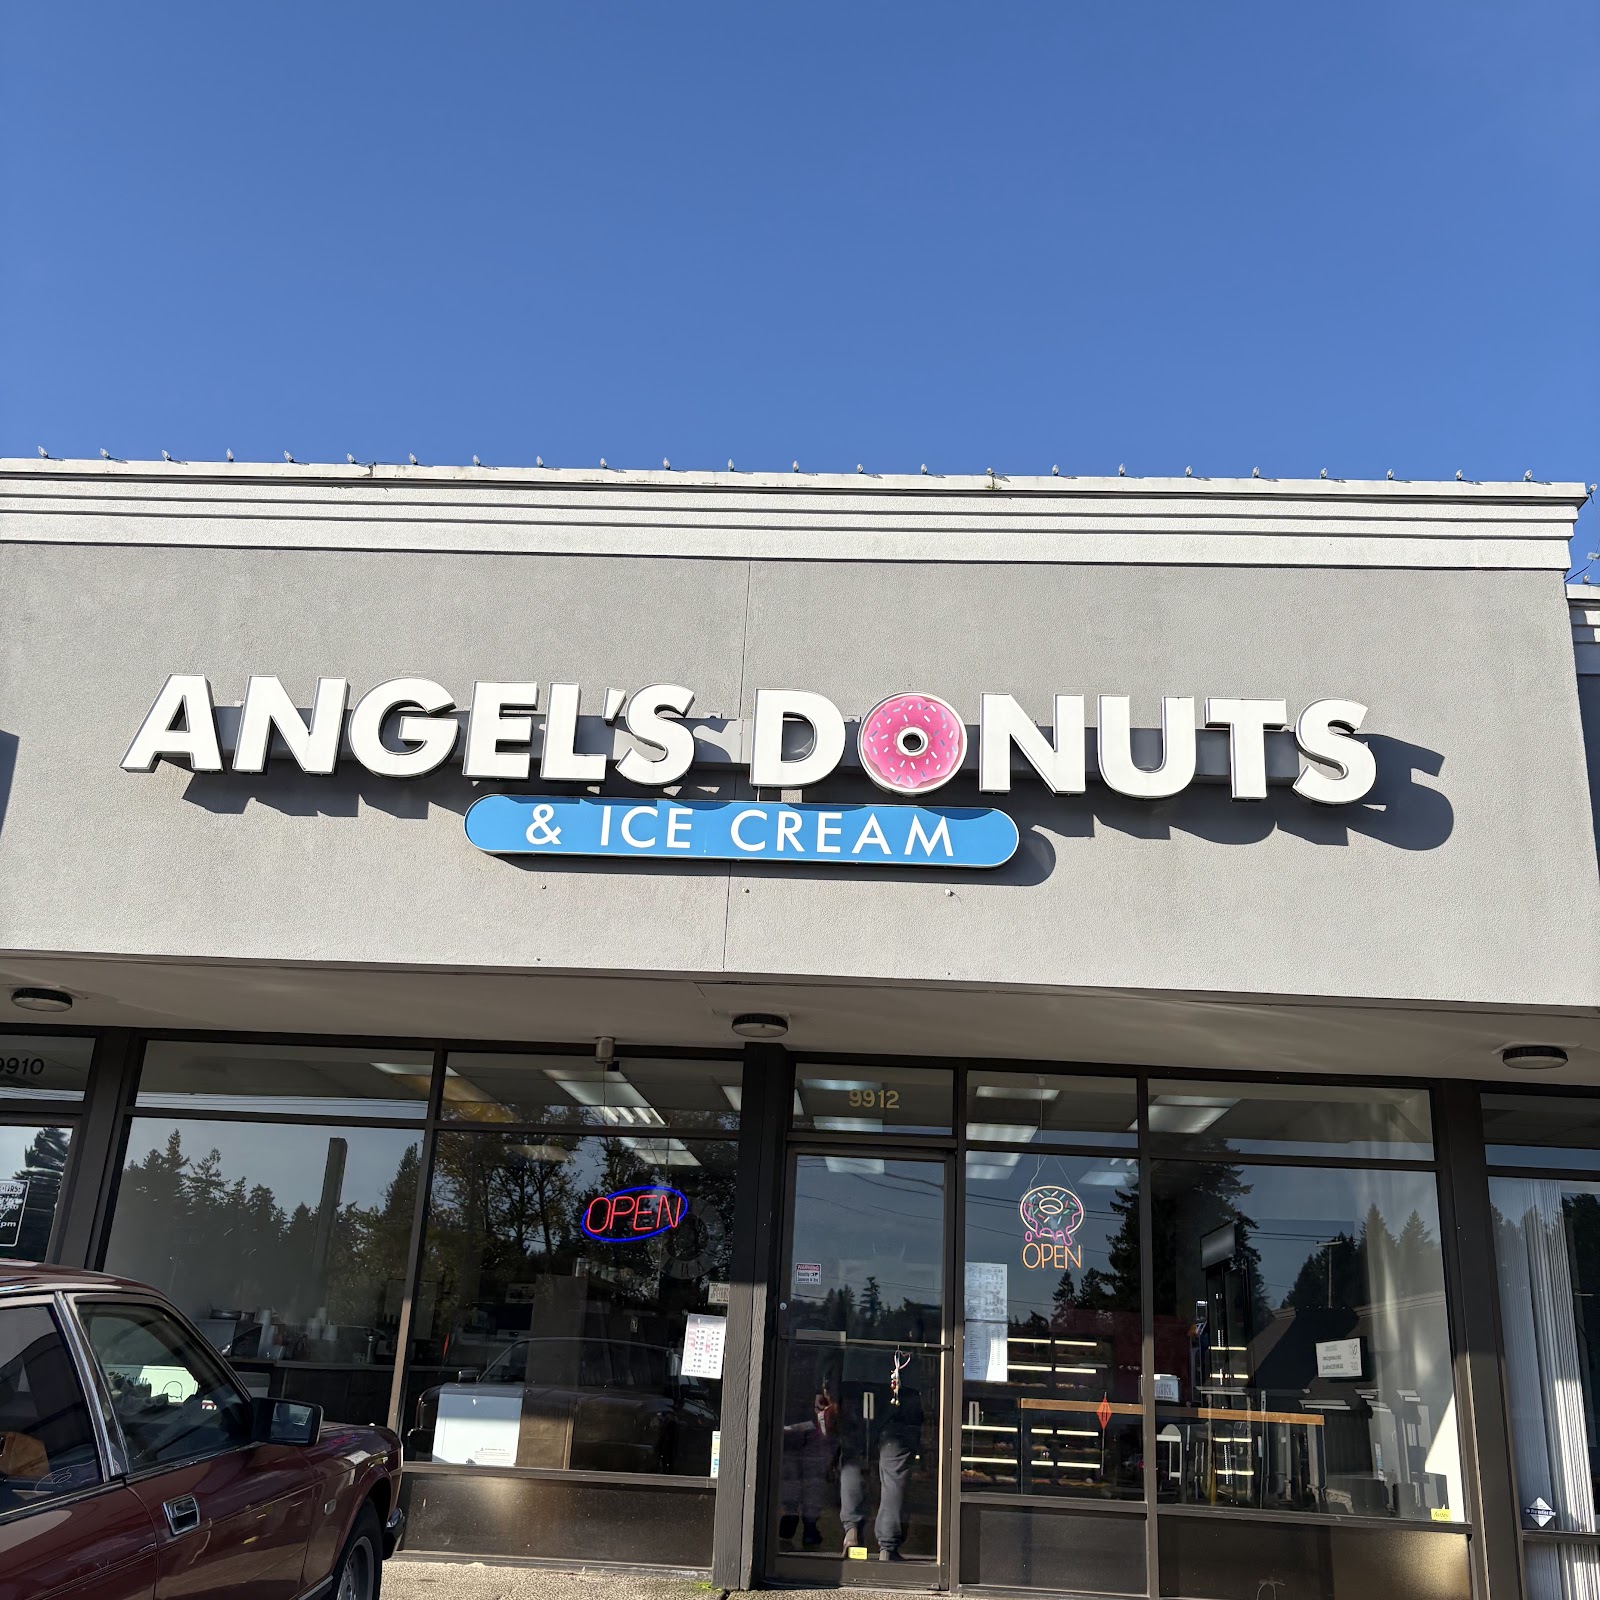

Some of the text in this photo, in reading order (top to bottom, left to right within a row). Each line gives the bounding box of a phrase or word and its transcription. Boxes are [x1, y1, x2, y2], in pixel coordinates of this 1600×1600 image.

[120, 674, 1378, 804] ANGEL'S DONUTS
[525, 804, 955, 859] & ICE CREAM
[848, 1090, 900, 1110] 9912
[587, 1194, 682, 1233] OPEN
[1022, 1243, 1082, 1270] OPEN
